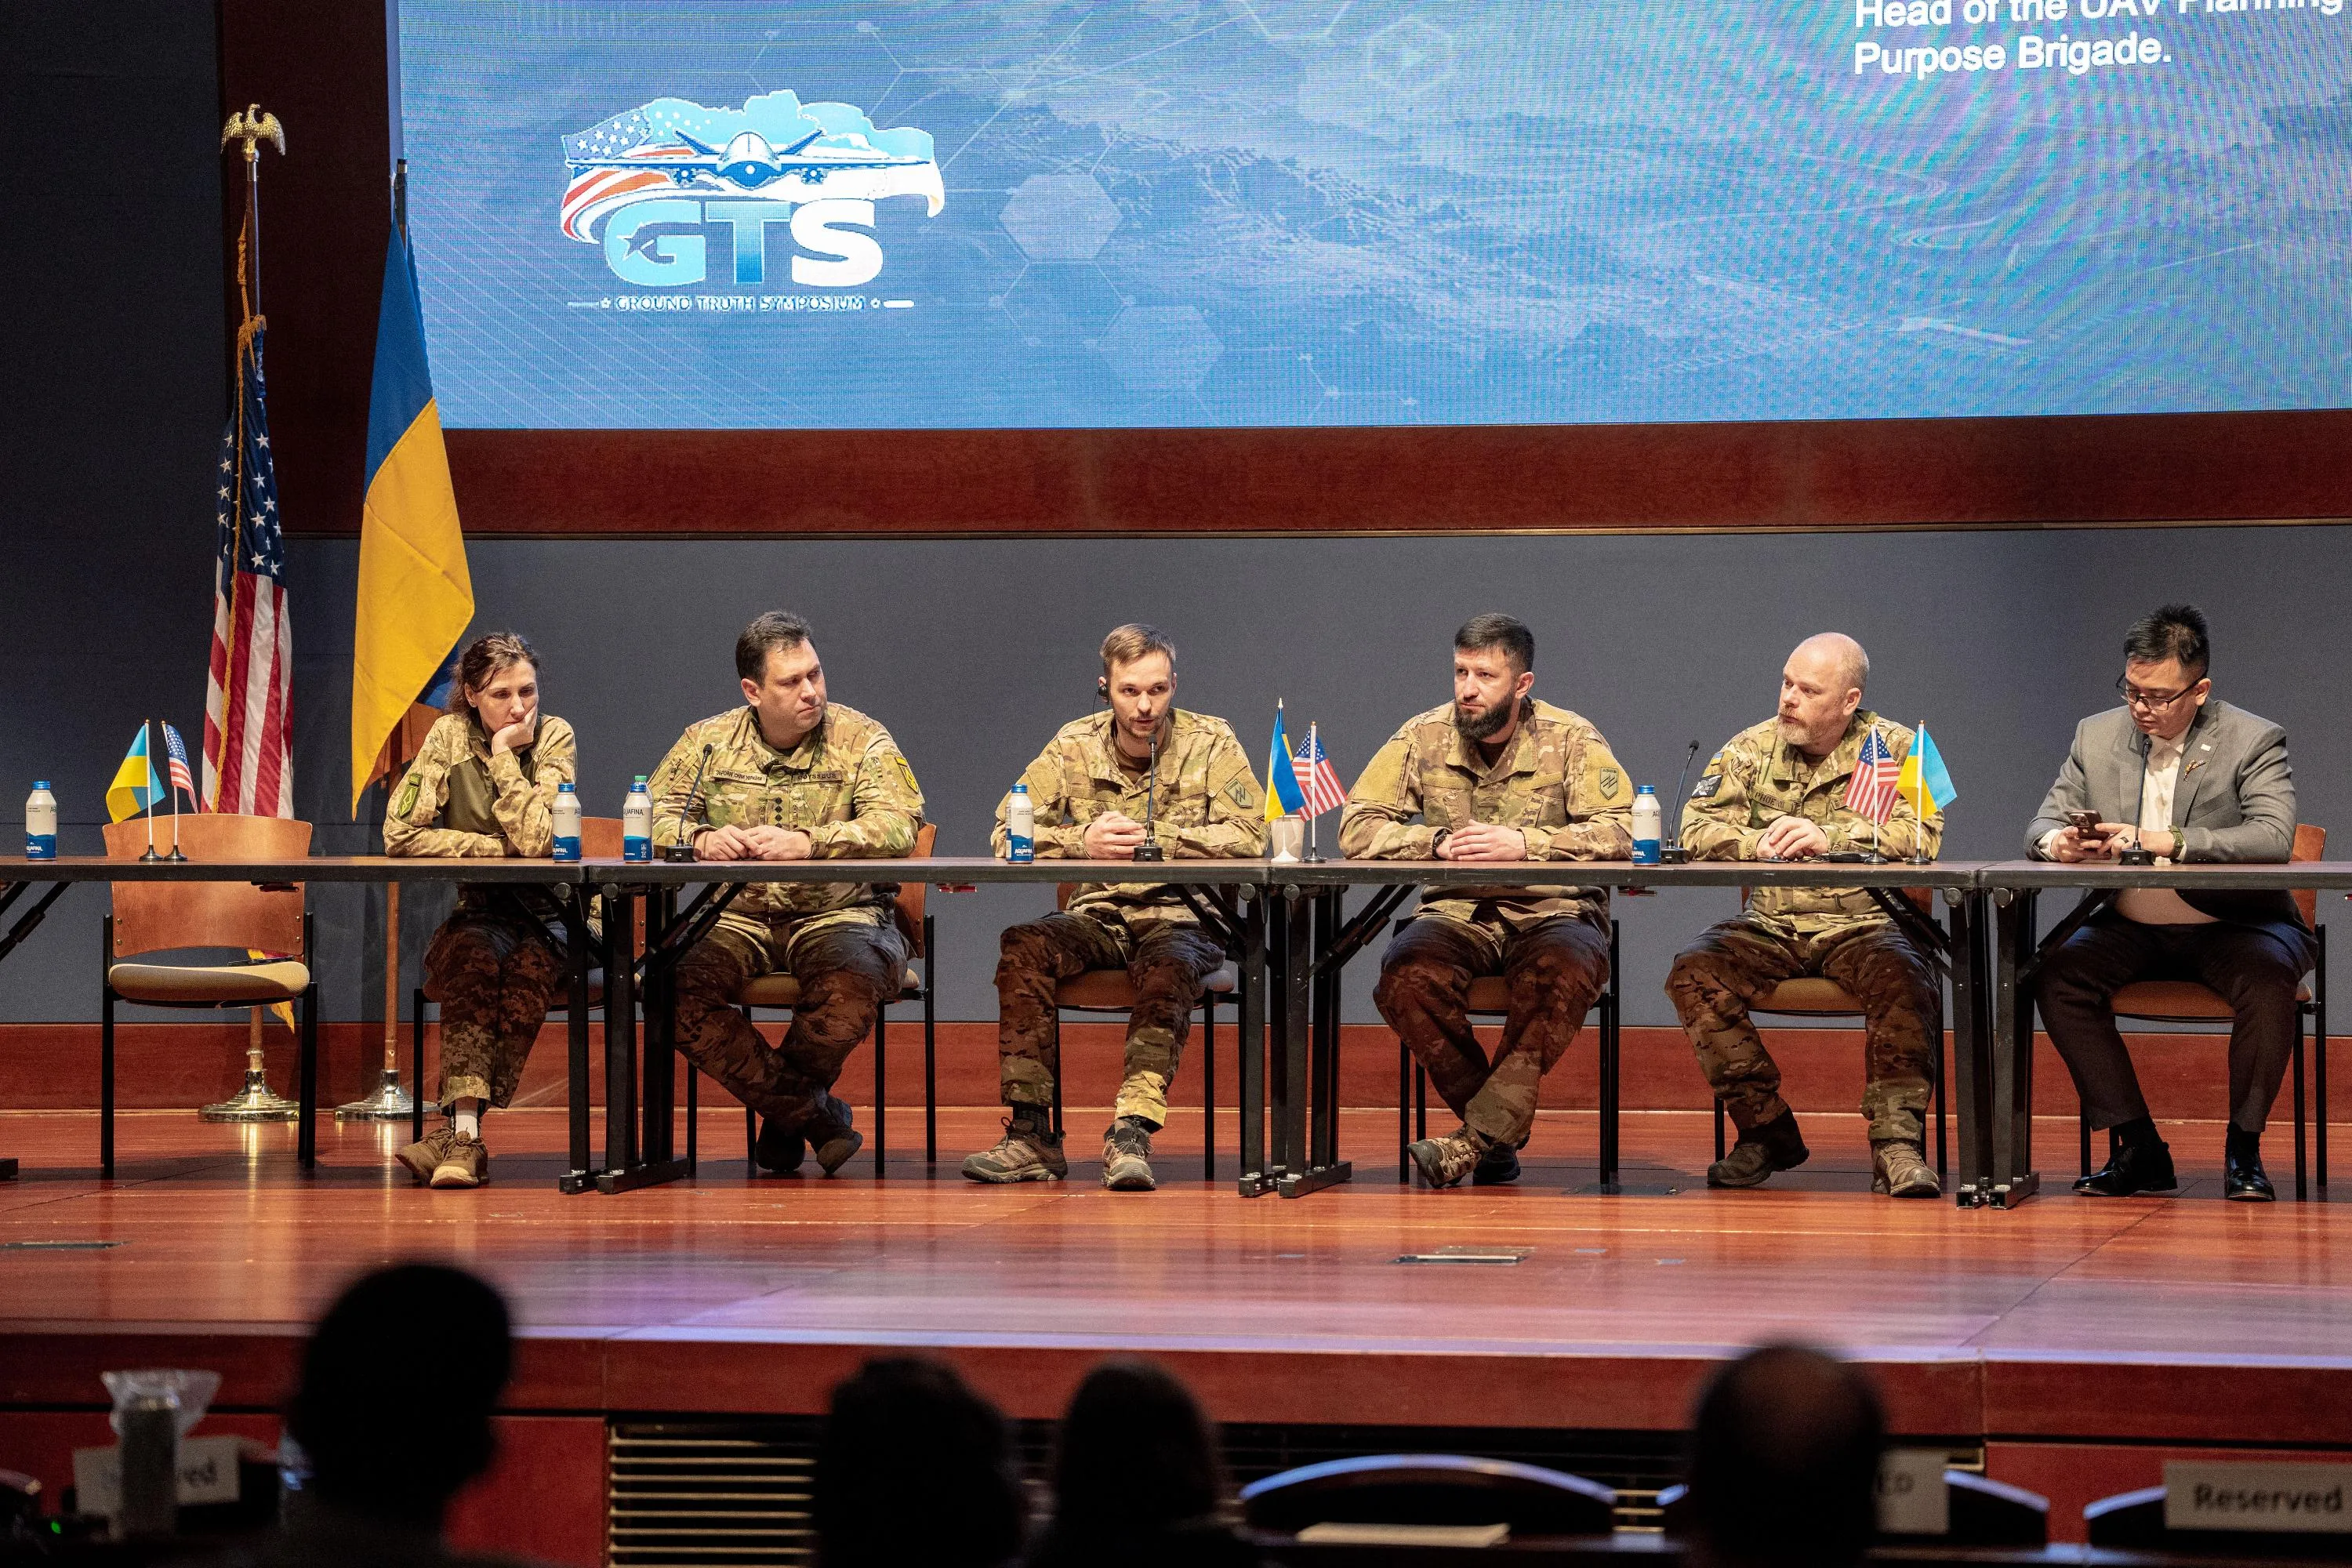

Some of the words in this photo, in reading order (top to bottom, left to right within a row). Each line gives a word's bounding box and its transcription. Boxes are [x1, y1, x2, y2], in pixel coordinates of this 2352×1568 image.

[1855, 0, 1951, 27] Head
[1962, 0, 2000, 24] of
[2009, 0, 2067, 21] the
[1854, 42, 2005, 81] Purpose
[2018, 31, 2171, 75] Brigade.
[604, 199, 884, 287] GTS
[615, 295, 692, 311] GROUND
[697, 295, 755, 311] TRUTH
[760, 295, 865, 311] SYMPOSIUM
[2194, 1482, 2343, 1513] Reserved
